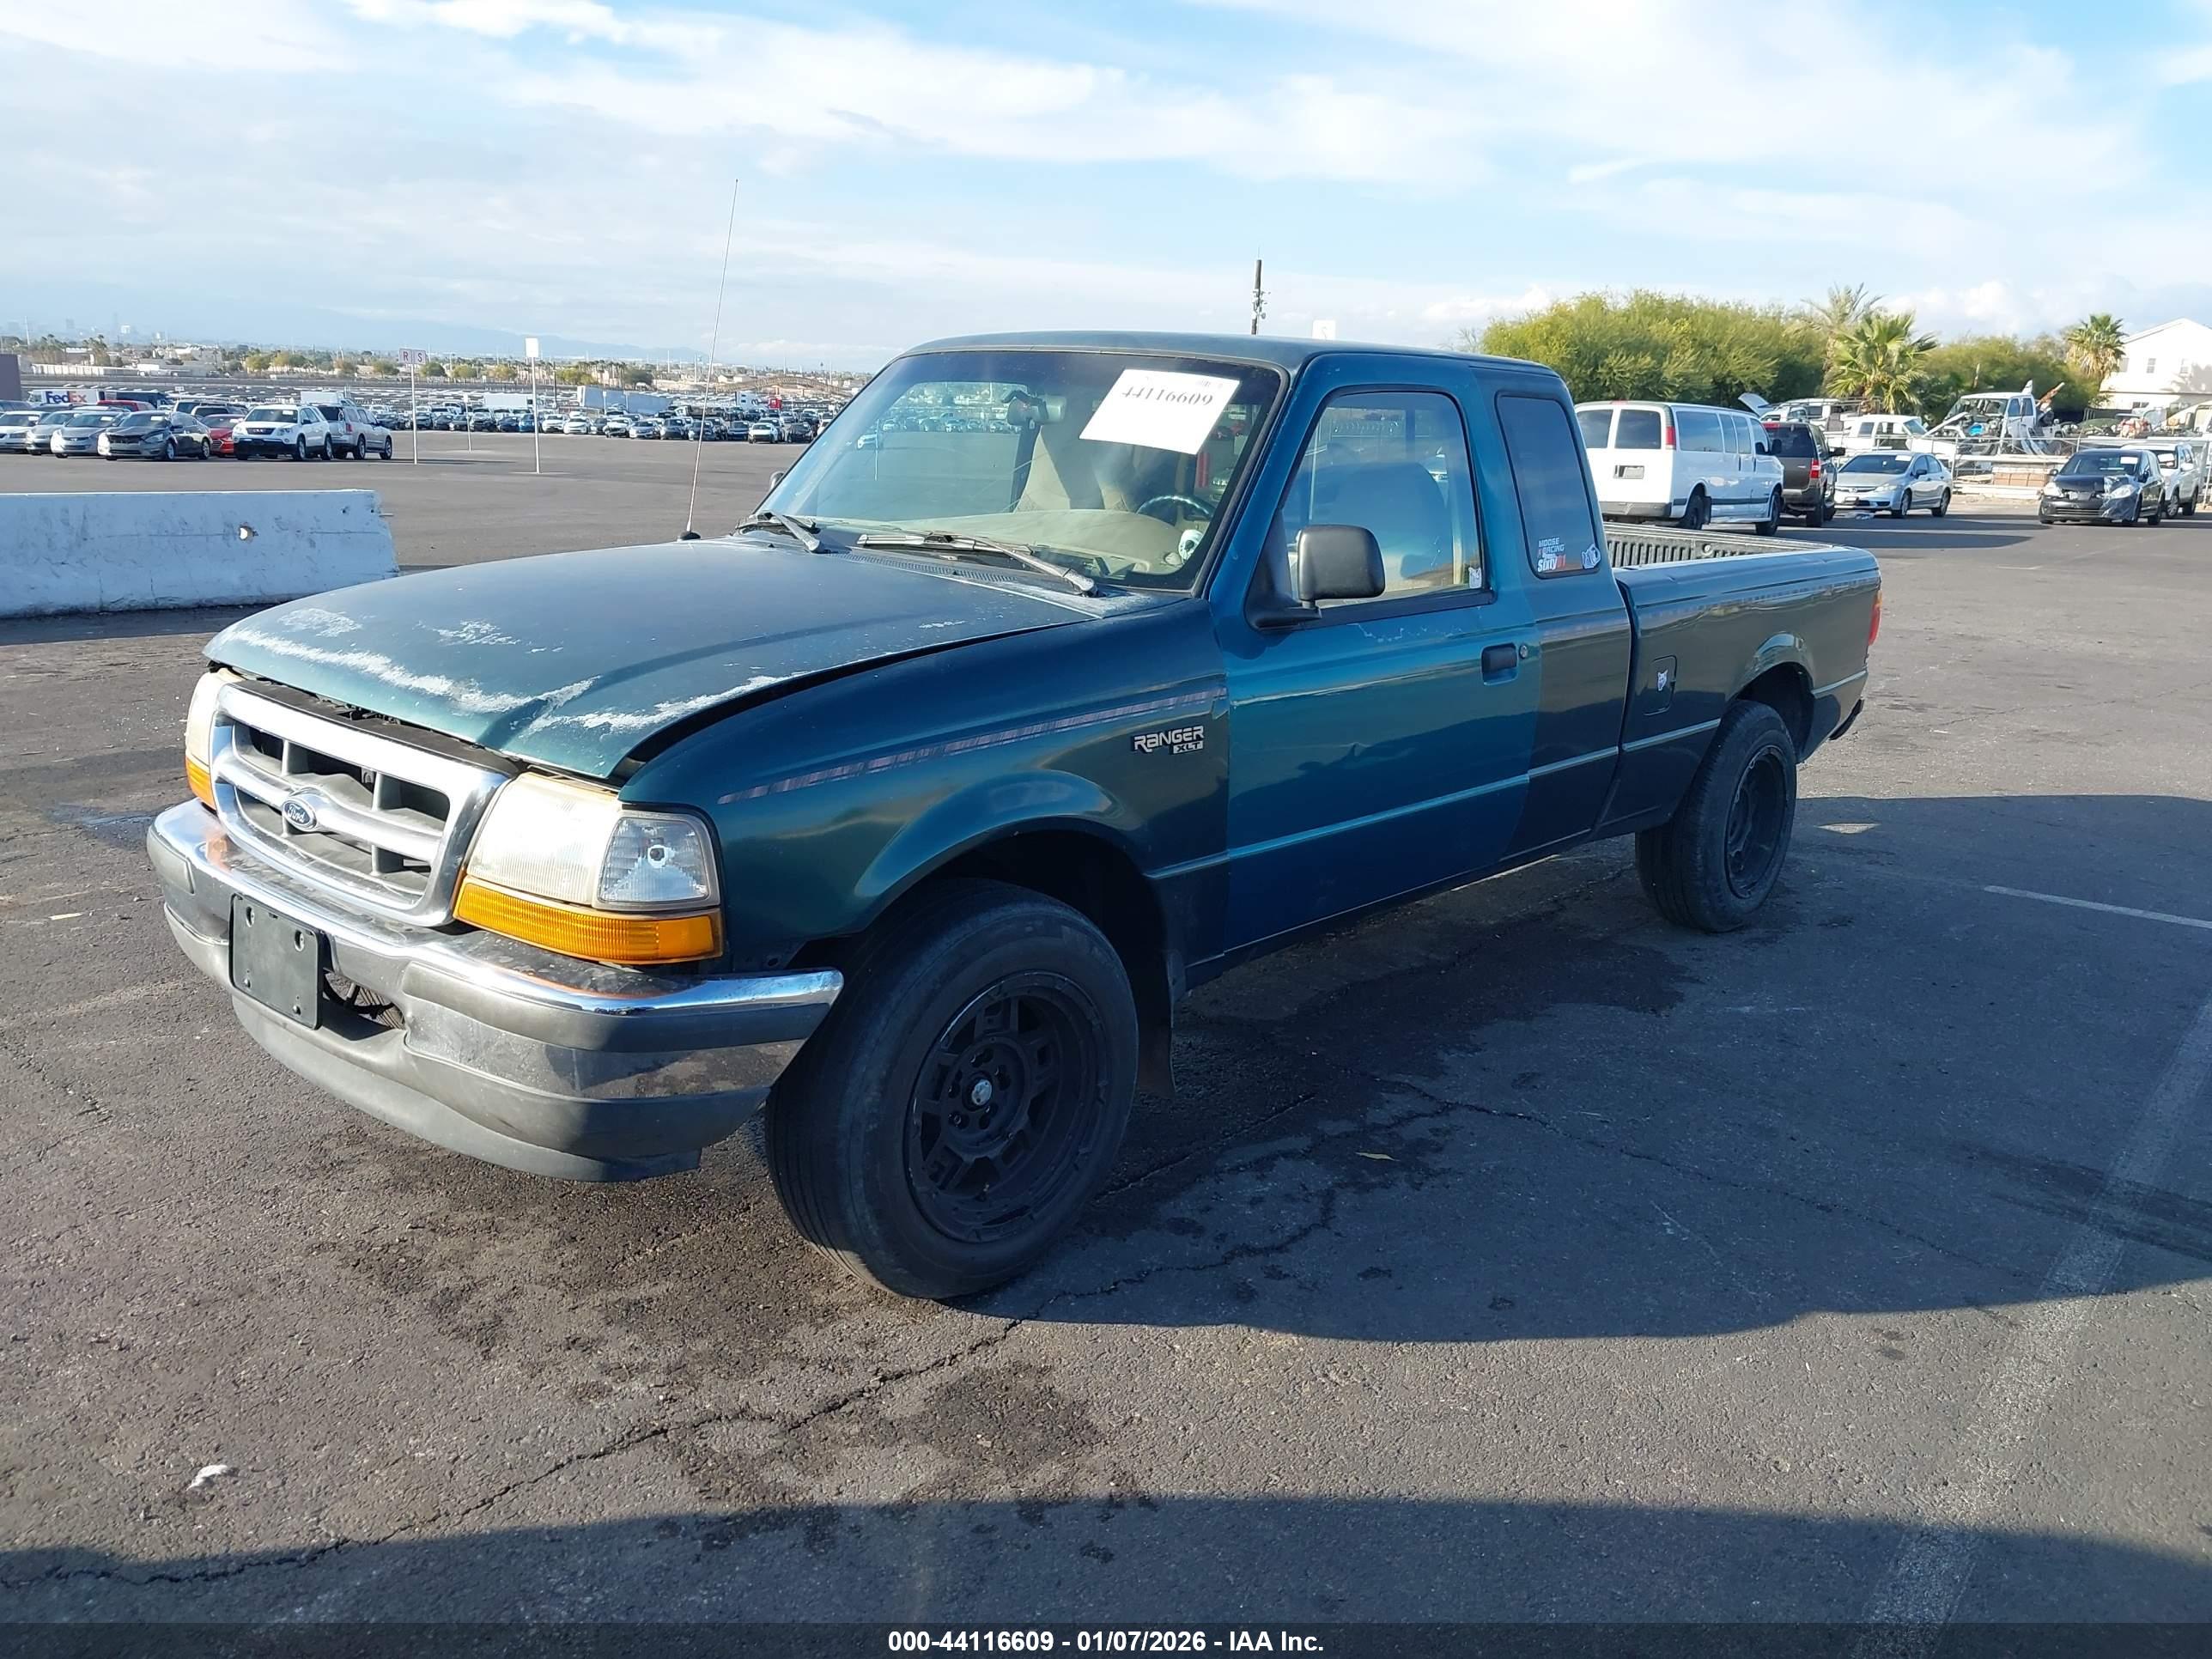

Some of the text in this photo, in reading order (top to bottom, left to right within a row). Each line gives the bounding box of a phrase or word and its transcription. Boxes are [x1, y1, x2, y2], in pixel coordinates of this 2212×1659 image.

[403, 351, 409, 362] R
[417, 352, 422, 362] S
[46, 391, 88, 404] FedEx
[1121, 386, 1213, 405] 44116609
[1133, 725, 1205, 753] RANGER
[1176, 741, 1200, 752] XLT
[287, 803, 306, 823] Ford
